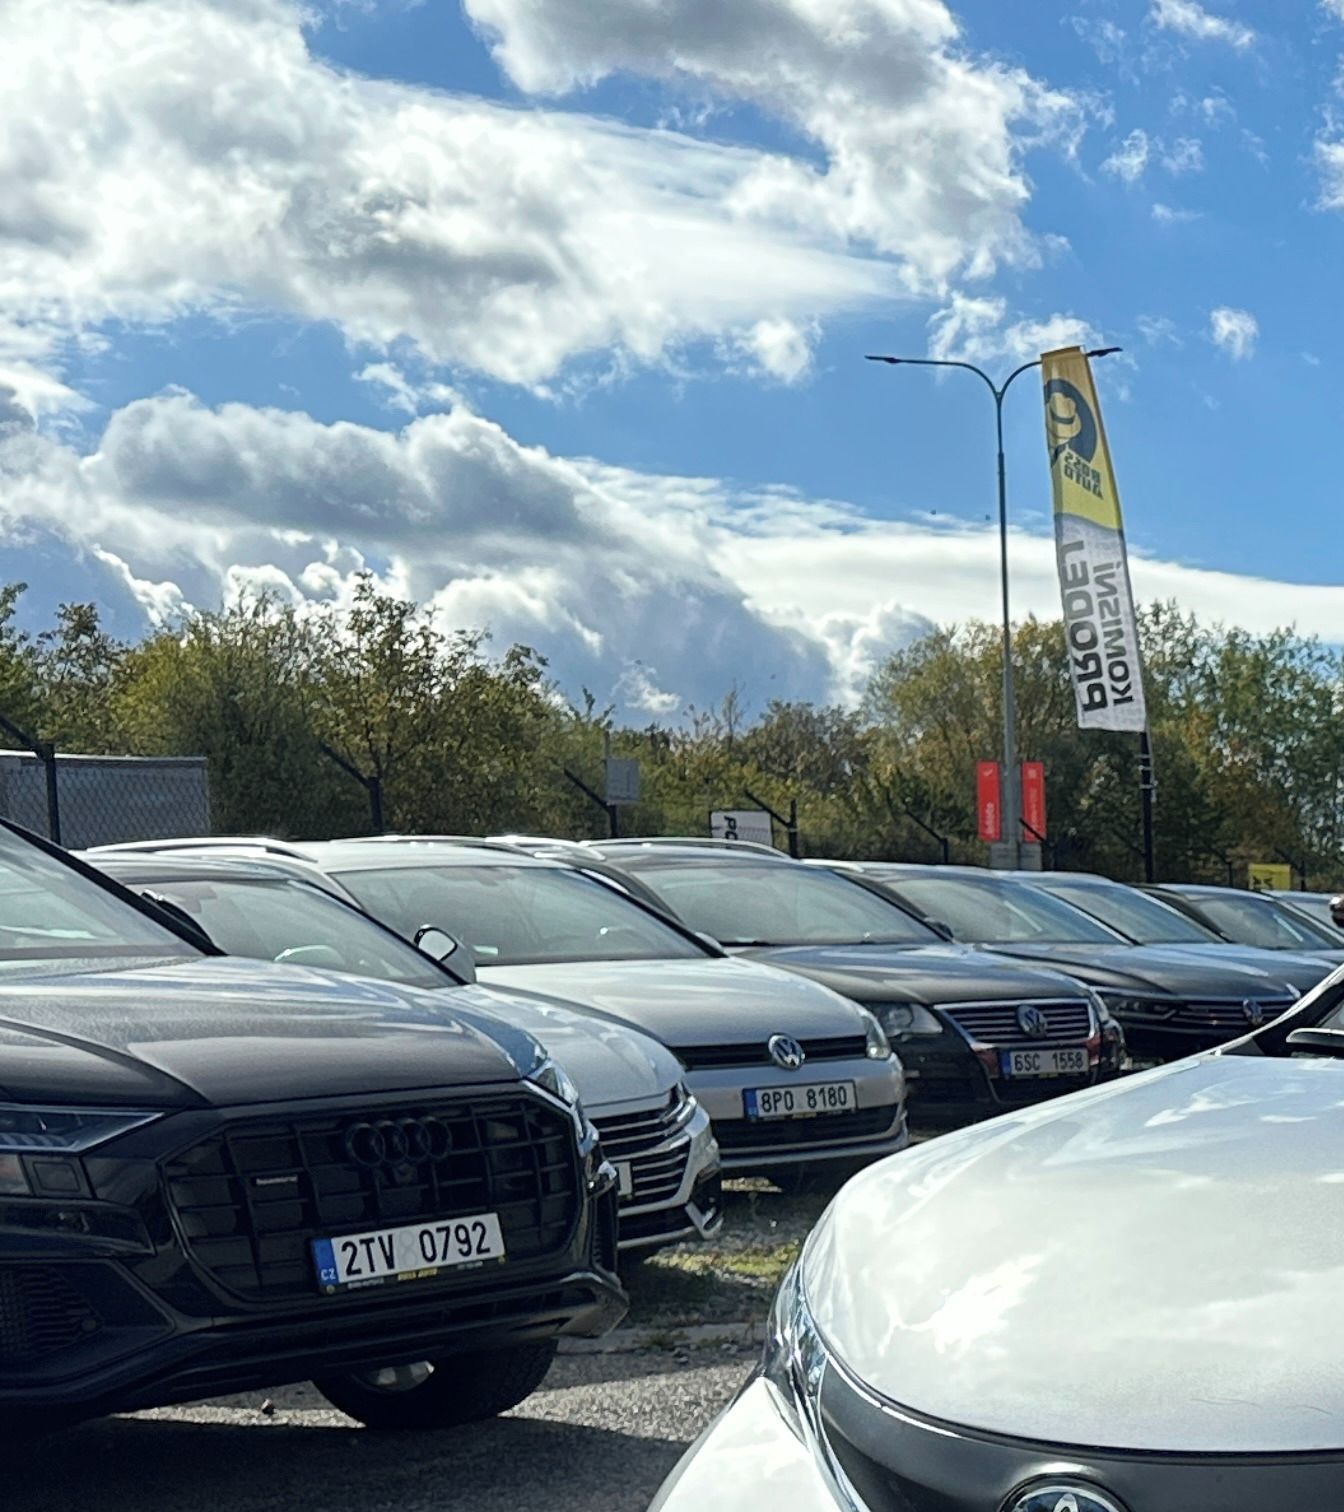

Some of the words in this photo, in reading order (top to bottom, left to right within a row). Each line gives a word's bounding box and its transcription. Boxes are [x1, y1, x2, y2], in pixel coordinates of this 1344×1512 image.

[806, 1085, 848, 1109] 8180
[340, 1233, 396, 1277] 2TV
[418, 1221, 492, 1263] 0792
[320, 1267, 337, 1281] CZ
